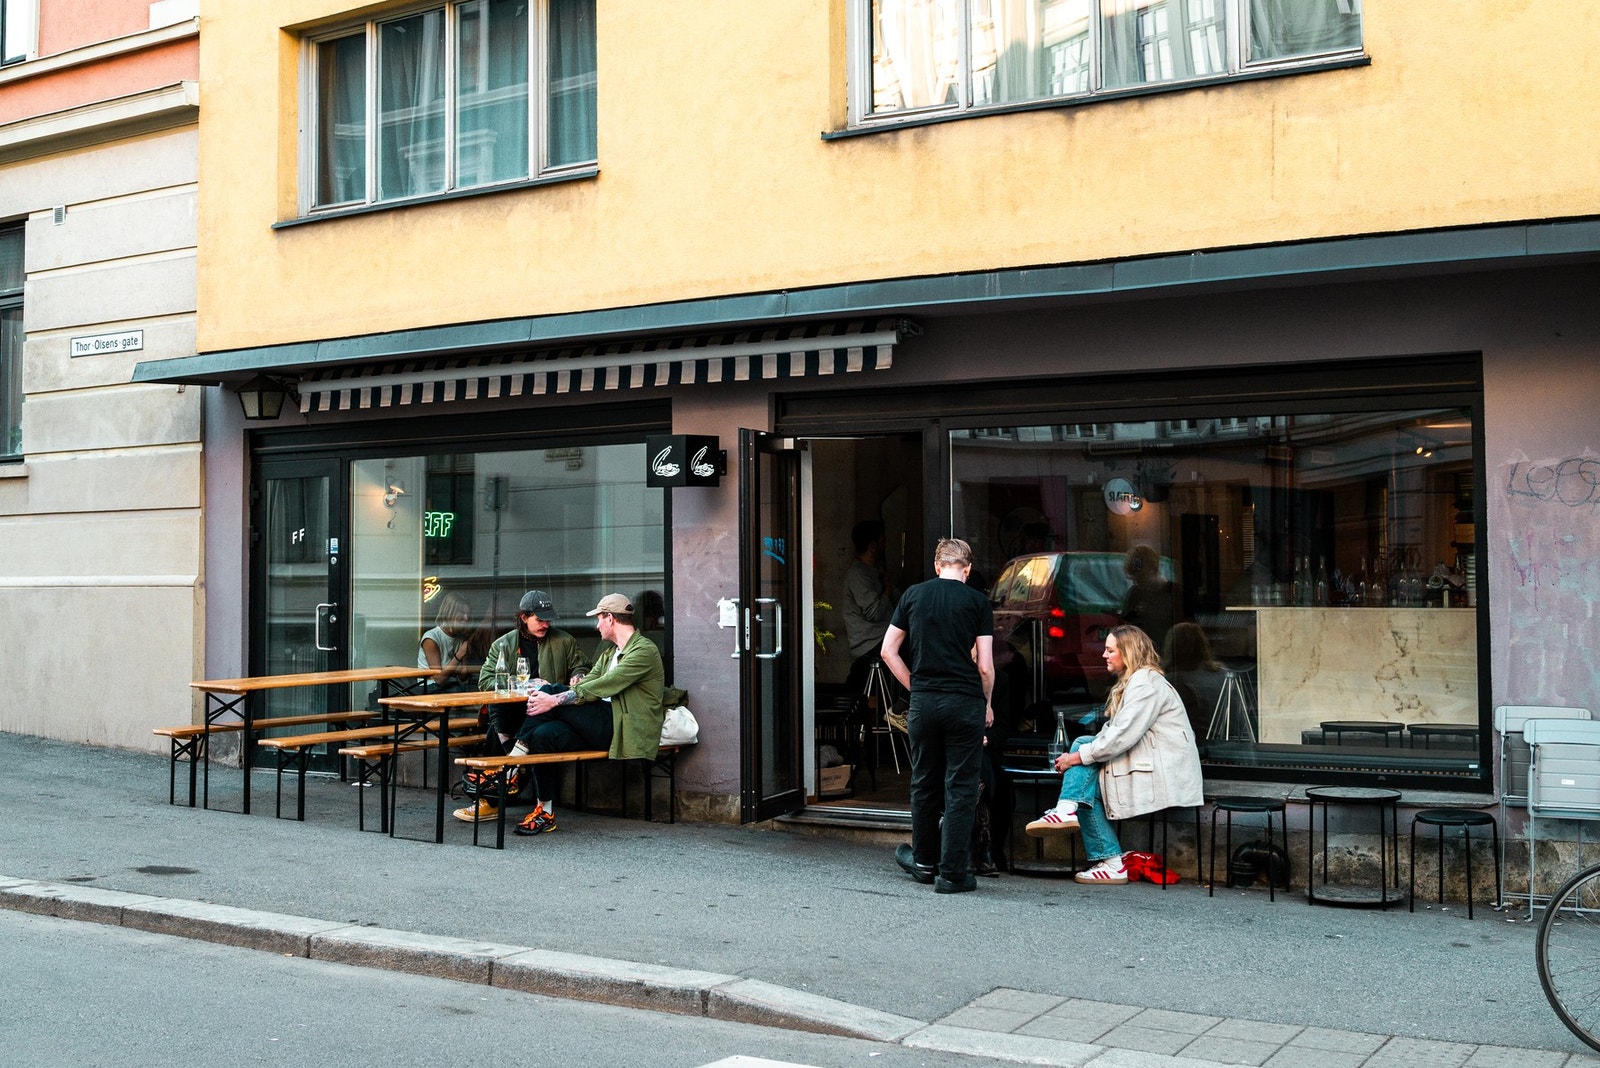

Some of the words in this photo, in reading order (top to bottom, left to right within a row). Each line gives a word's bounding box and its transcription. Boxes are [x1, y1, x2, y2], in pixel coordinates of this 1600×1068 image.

[75, 342, 91, 352] Thor
[94, 339, 118, 350] Olsens
[122, 336, 138, 349] gate
